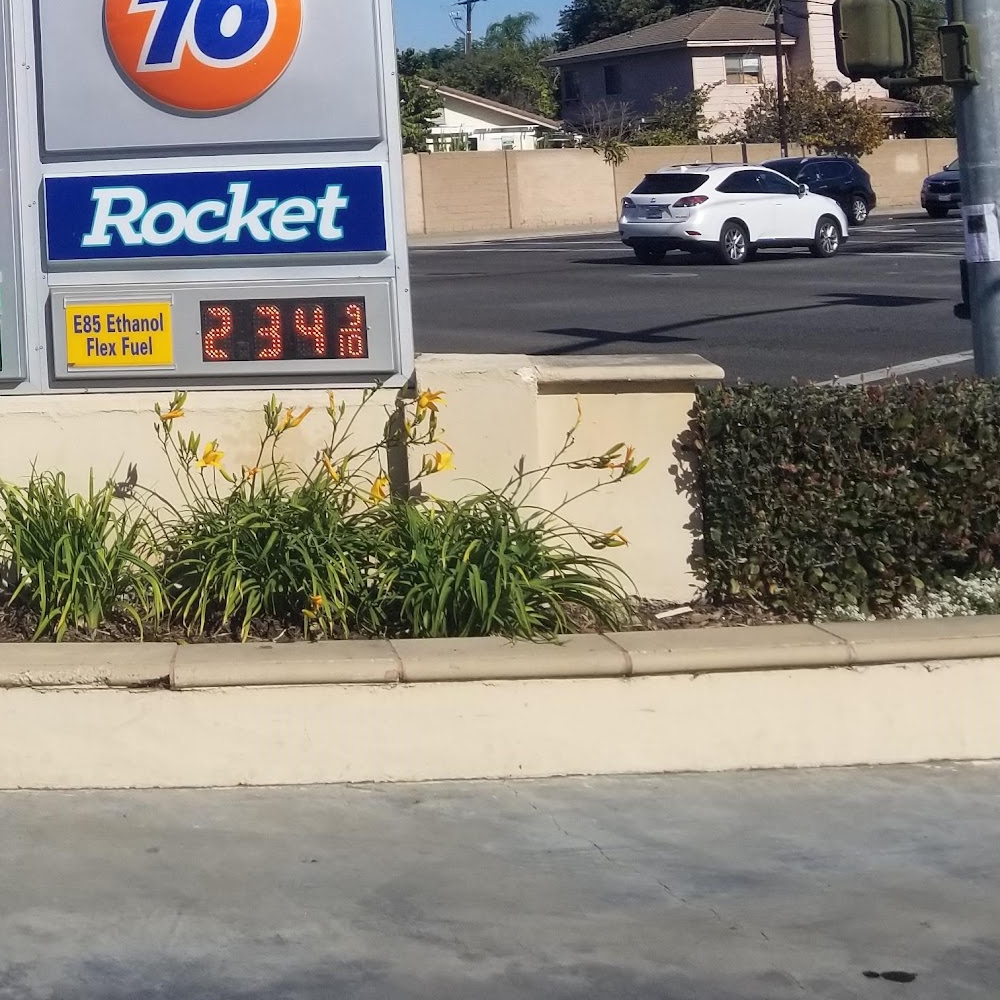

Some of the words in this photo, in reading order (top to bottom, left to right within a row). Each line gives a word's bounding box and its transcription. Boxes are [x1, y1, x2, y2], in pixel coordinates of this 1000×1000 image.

[81, 180, 350, 248] Rocket
[73, 314, 101, 335] E85
[106, 312, 164, 334] Ethanol
[86, 336, 116, 357] Flex
[121, 334, 153, 356] Fuel
